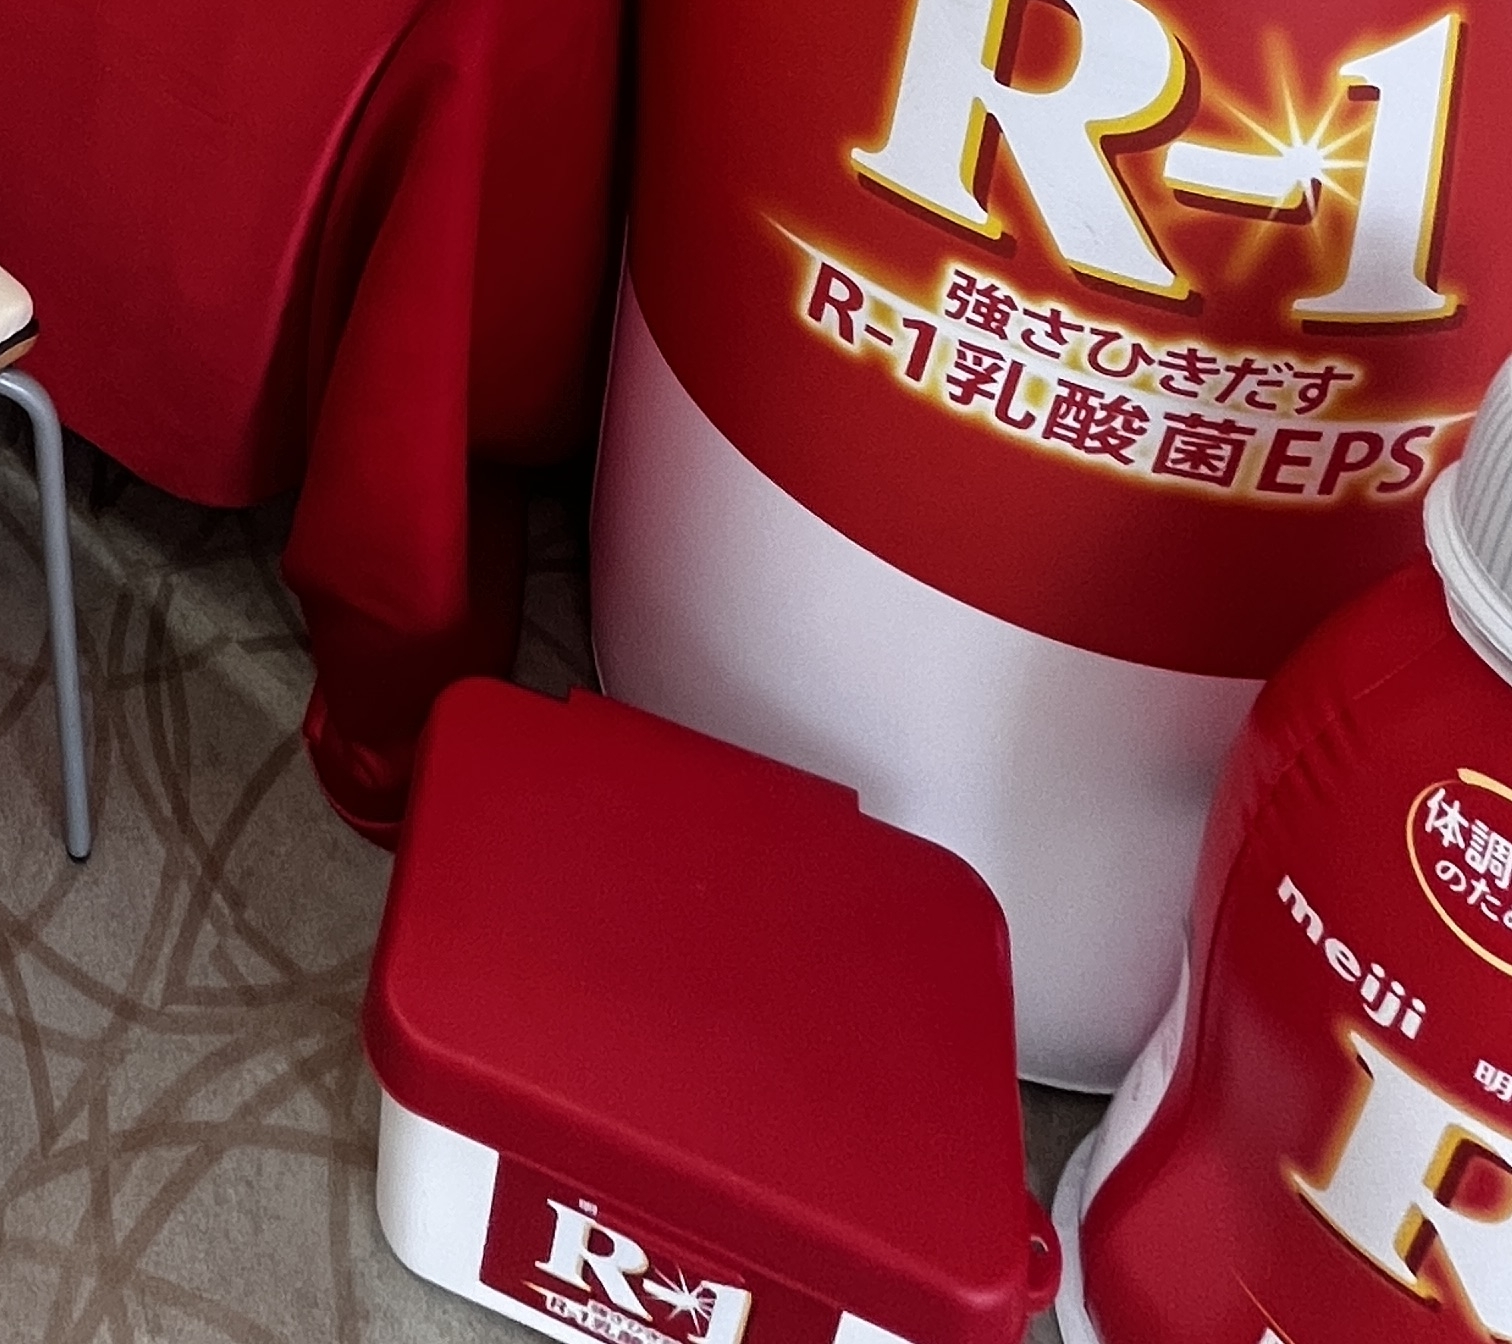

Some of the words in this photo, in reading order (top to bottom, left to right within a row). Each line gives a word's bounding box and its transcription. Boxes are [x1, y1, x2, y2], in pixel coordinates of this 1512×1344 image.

[806, 260, 1437, 497] R-1乳酸菌EPS
[945, 268, 1356, 416] 強さひきだす
[1277, 874, 1428, 1040] meiji
[534, 1197, 753, 1344] R-1
